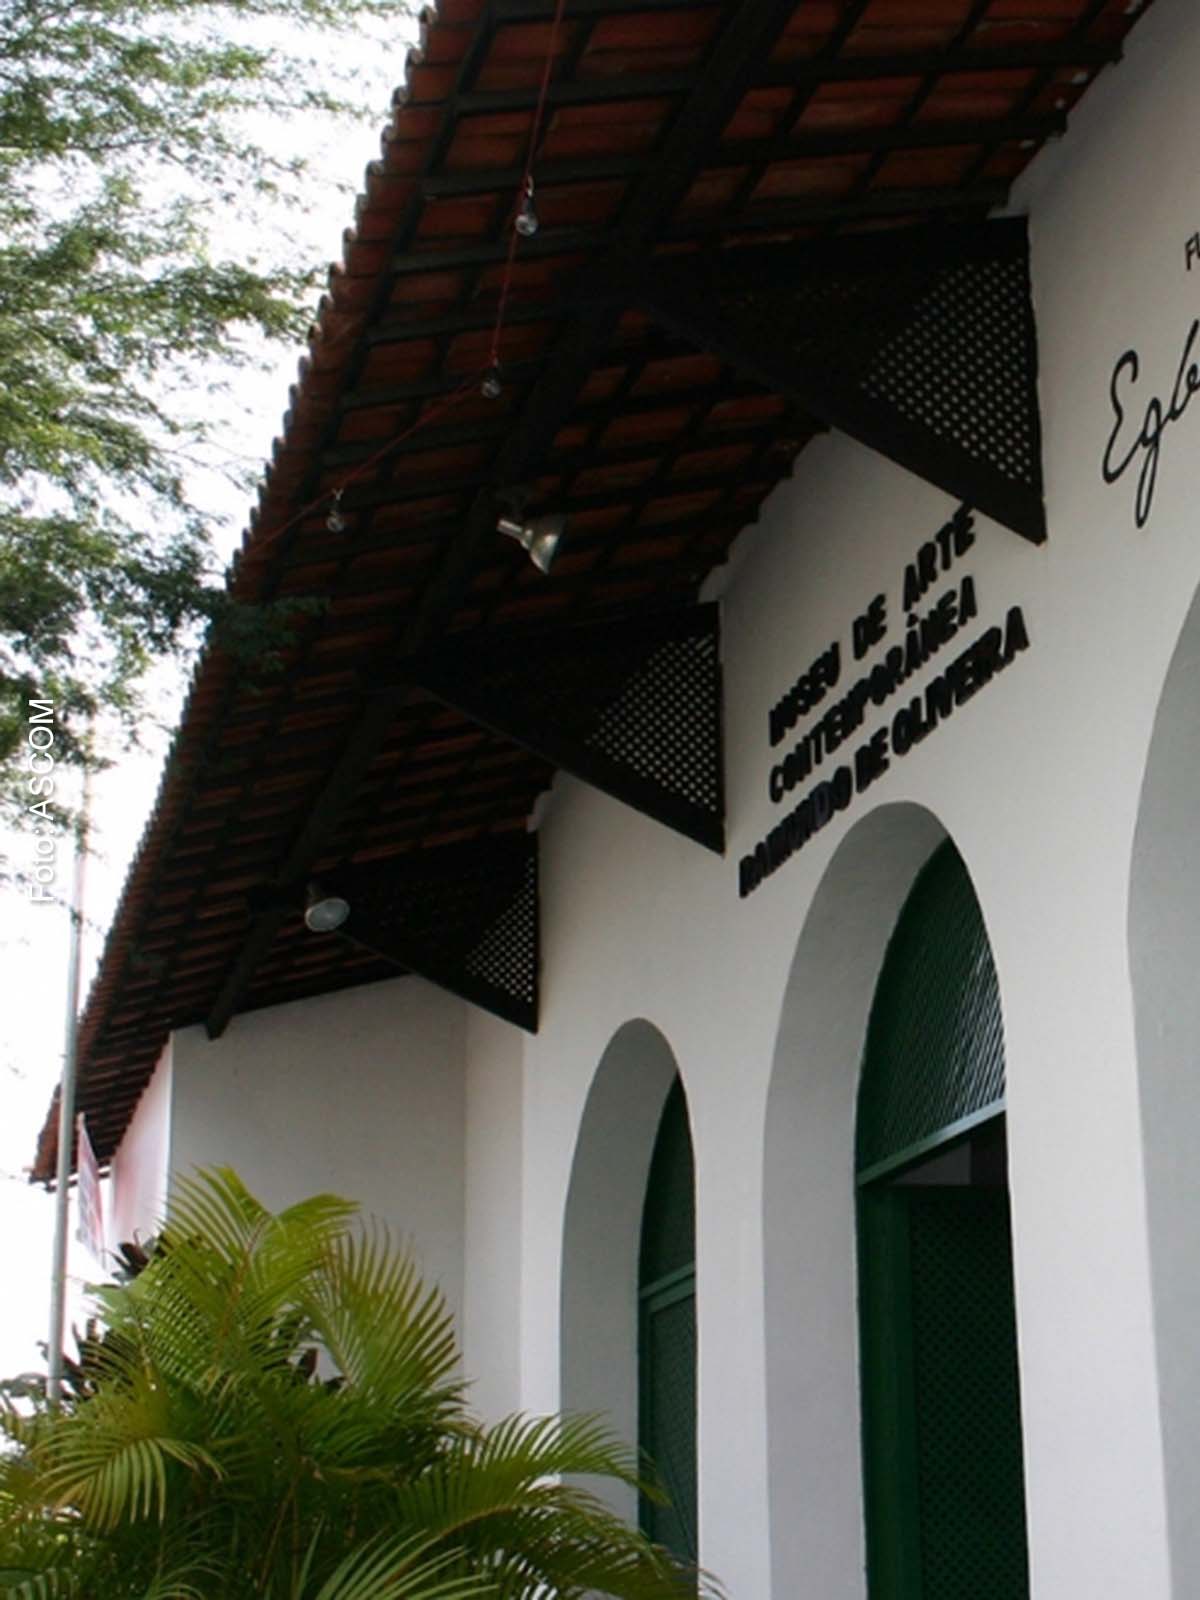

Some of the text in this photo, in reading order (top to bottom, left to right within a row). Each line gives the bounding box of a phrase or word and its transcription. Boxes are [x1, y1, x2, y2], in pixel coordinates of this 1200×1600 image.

[853, 594, 888, 660] DE
[903, 504, 976, 612] ARTE
[855, 726, 890, 794] DE
[892, 606, 1030, 756] OLIVEIRA
